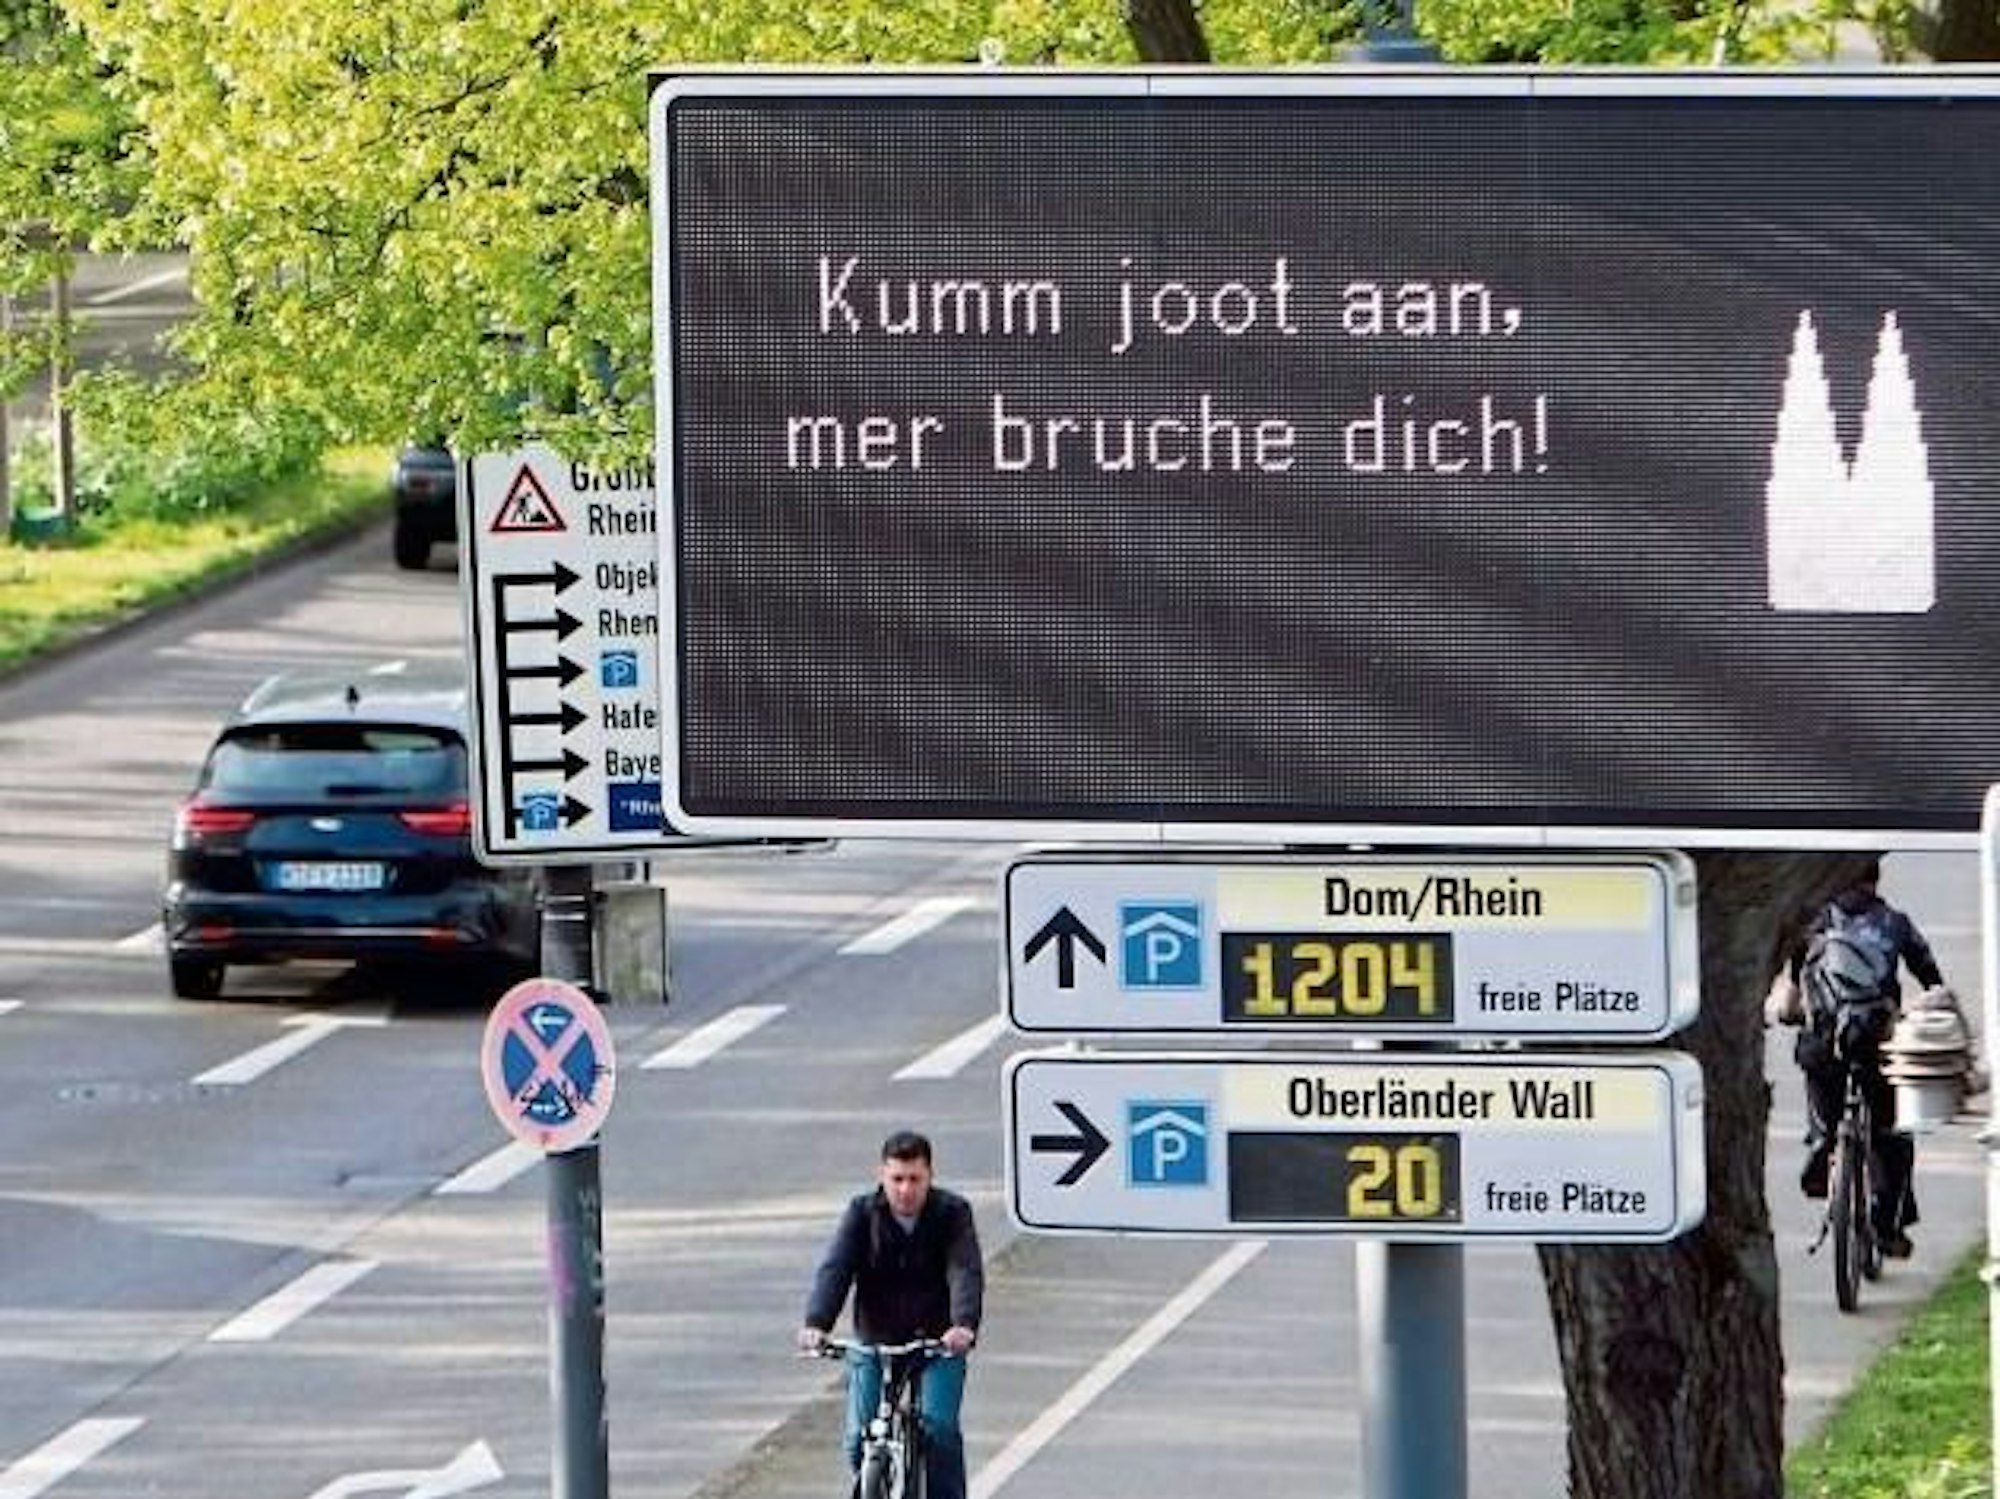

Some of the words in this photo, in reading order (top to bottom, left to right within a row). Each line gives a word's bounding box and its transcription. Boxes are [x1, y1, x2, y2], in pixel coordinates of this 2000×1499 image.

[817, 255, 1061, 336] Kumm
[1110, 257, 1299, 354] joot
[1341, 282, 1523, 337] aan,
[786, 415, 945, 471] mer
[993, 394, 1296, 471] bruche
[1344, 394, 1550, 473] dich!
[605, 750, 660, 784] Baye
[1323, 877, 1543, 921] Dom/Rhein
[1242, 943, 1436, 1016] 1204
[1478, 983, 1542, 1013] freie
[1555, 982, 1640, 1016] Plätze
[1288, 1077, 1495, 1121] Oberländer
[1512, 1081, 1594, 1120] Wall
[1346, 1146, 1441, 1218] 20
[1486, 1184, 1548, 1214] freie
[1561, 1183, 1647, 1217] Plätze
